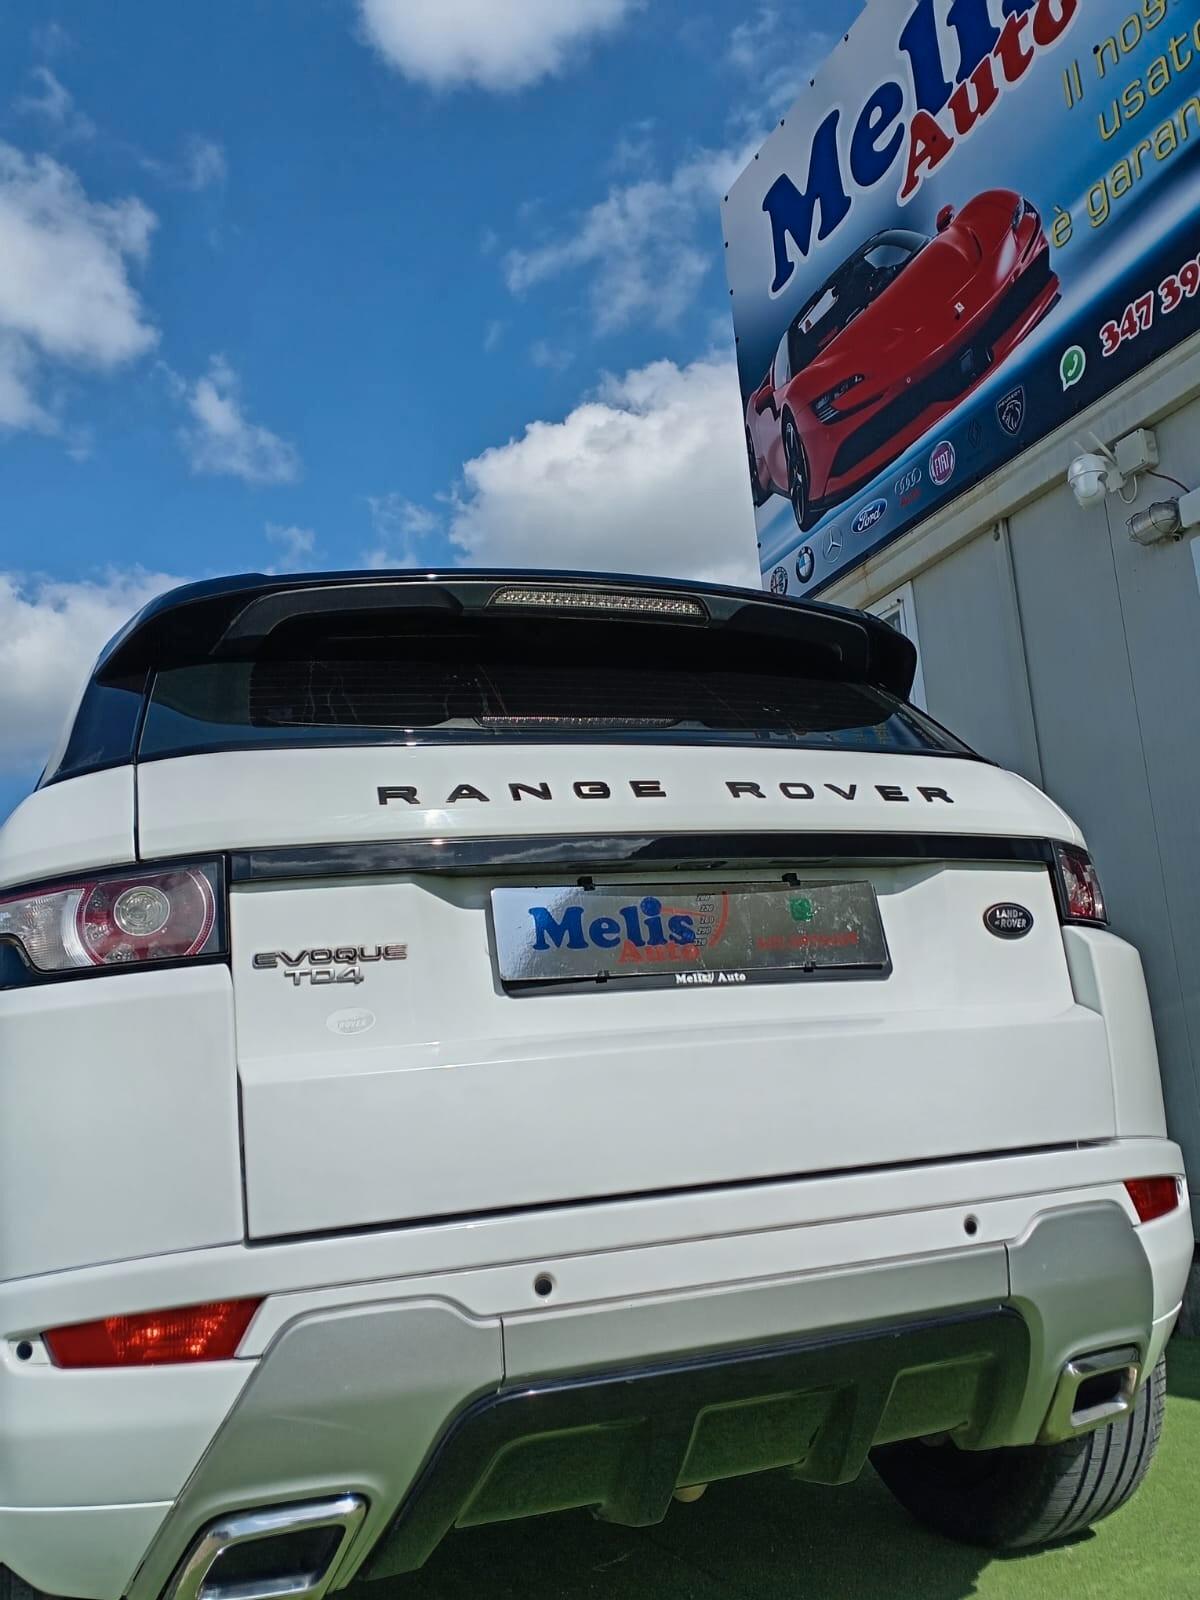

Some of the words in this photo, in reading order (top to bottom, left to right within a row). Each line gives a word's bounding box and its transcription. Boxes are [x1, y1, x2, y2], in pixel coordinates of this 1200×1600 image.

[762, 0, 1036, 293] Meli
[1052, 204, 1073, 248] è
[1100, 290, 1154, 357] 347
[1158, 252, 1200, 314] 39
[934, 450, 950, 477] FIAT
[857, 505, 881, 531] Ford
[377, 779, 667, 805] RANGE
[725, 780, 954, 804] ROVER
[528, 896, 697, 950] Melis
[996, 909, 1018, 919] LAND
[1000, 918, 1027, 929] ROVER
[252, 943, 408, 970] EVOQUE
[616, 939, 701, 965] Auto
[284, 966, 365, 986] TD4
[718, 972, 747, 983] Auto
